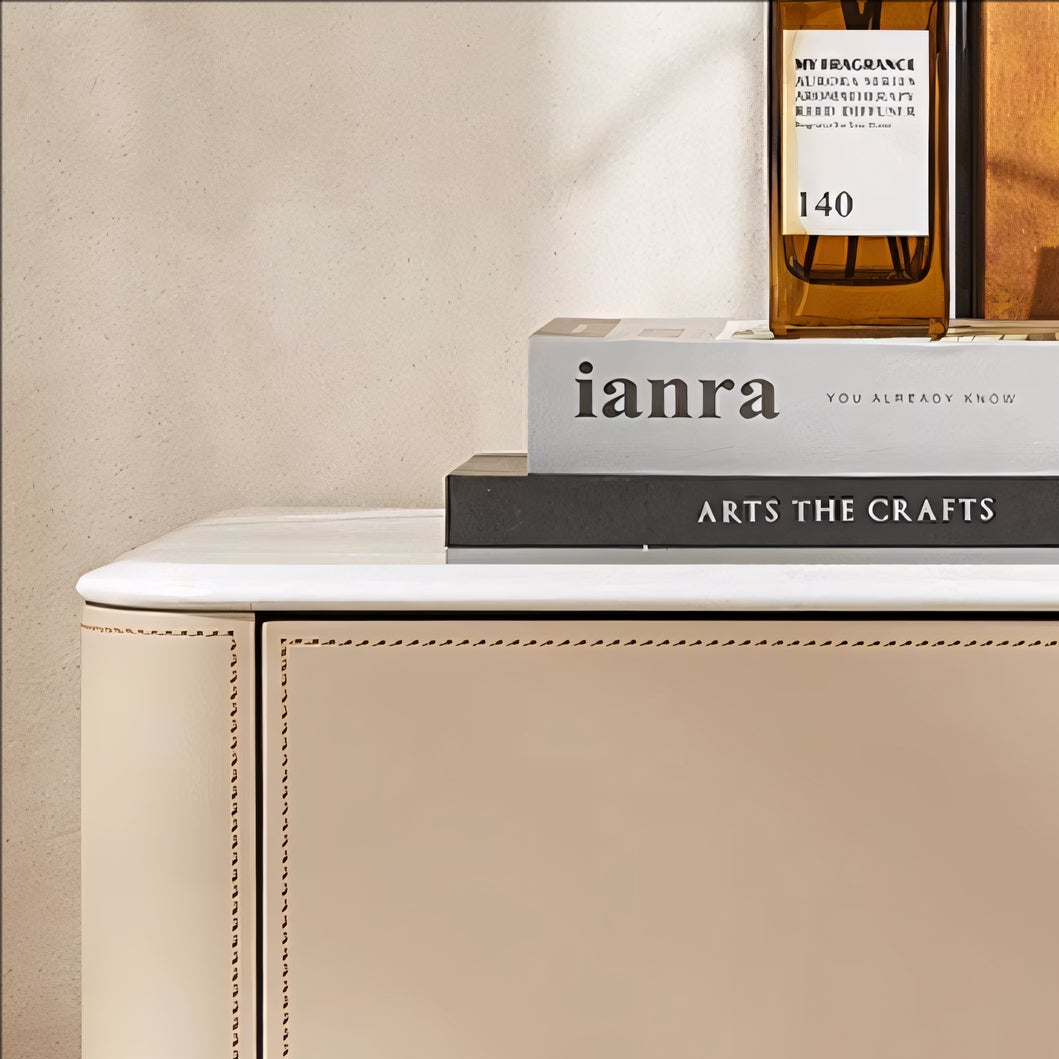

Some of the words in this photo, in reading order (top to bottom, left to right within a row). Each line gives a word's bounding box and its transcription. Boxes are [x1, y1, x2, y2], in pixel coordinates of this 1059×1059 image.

[800, 190, 854, 218] 140
[574, 361, 780, 419] ianra
[826, 392, 862, 404] YOU
[697, 499, 779, 524] ARTS
[792, 498, 855, 522] THE
[867, 497, 994, 523] CRAFTS
